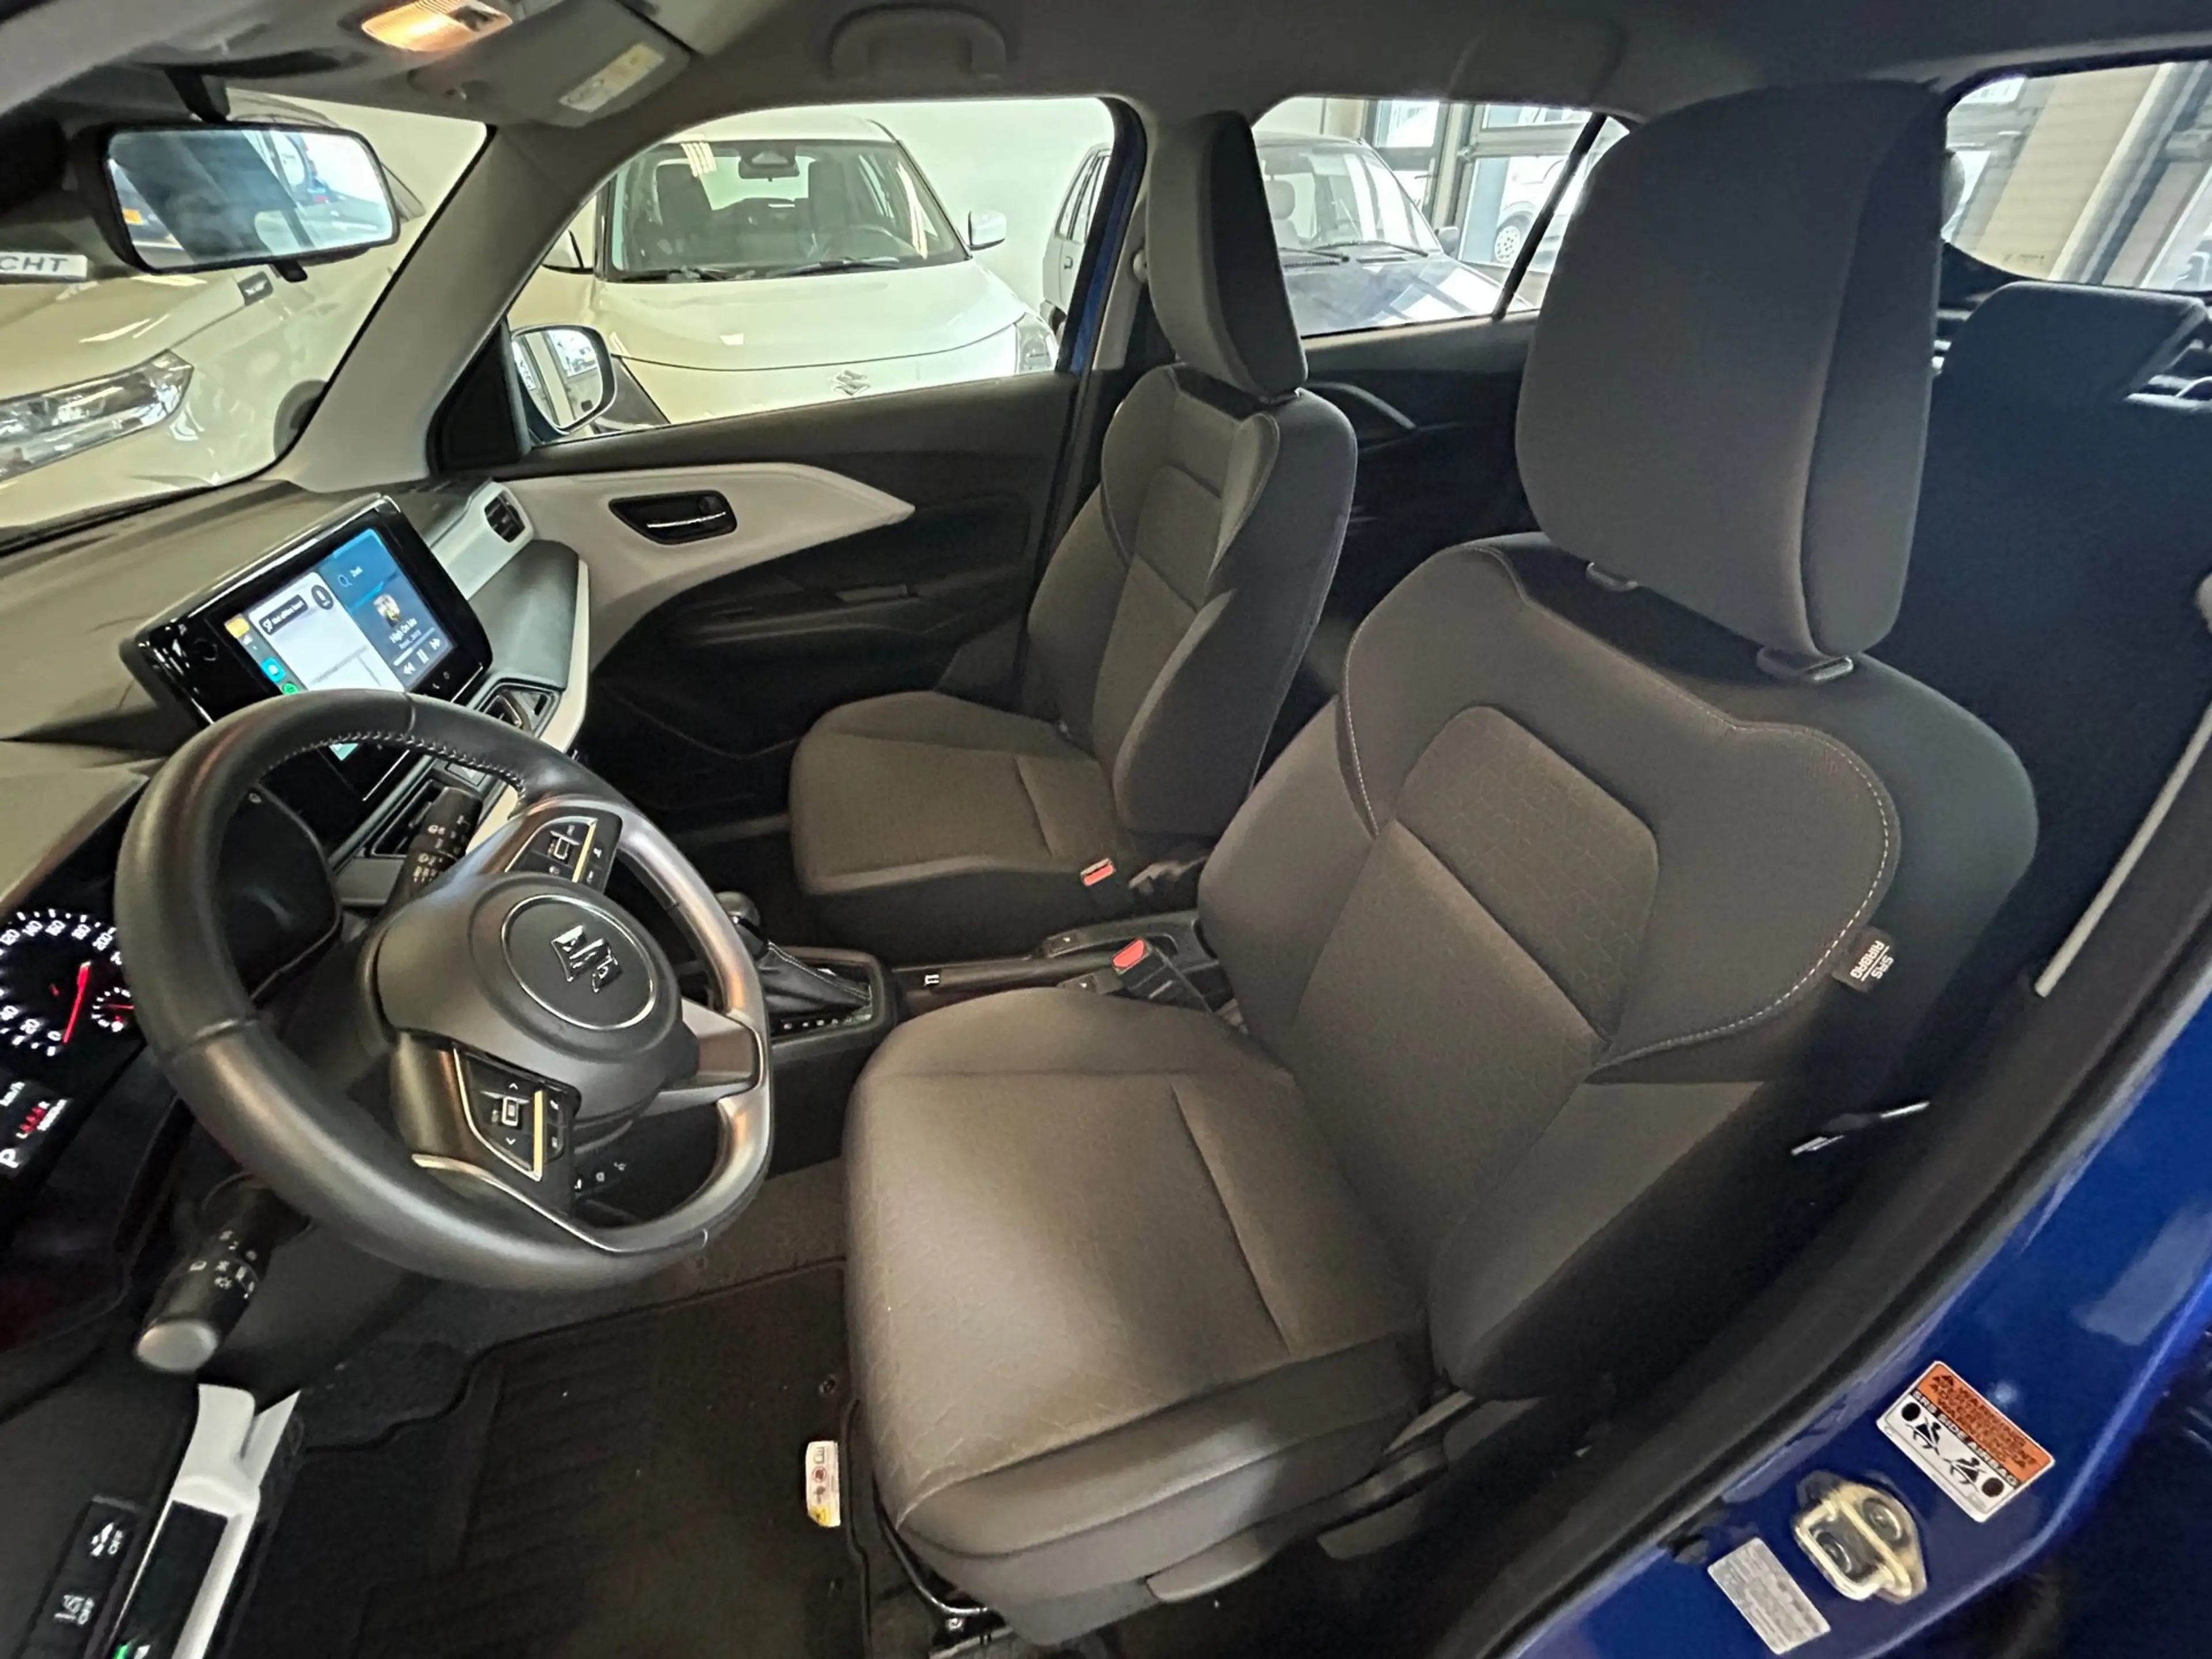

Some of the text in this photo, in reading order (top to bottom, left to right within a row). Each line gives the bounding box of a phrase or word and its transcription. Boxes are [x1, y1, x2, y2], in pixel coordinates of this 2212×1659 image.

[92, 932, 113, 952] 200
[1850, 940, 1885, 979] AIRBAG
[1870, 955, 1894, 979] SRS
[20, 1018, 40, 1035] 20
[47, 1030, 62, 1041] 0
[0, 1148, 20, 1169] P
[1959, 1386, 2027, 1447] WARNING
[1911, 1389, 2020, 1487] SRS SIDE AIRBAG
